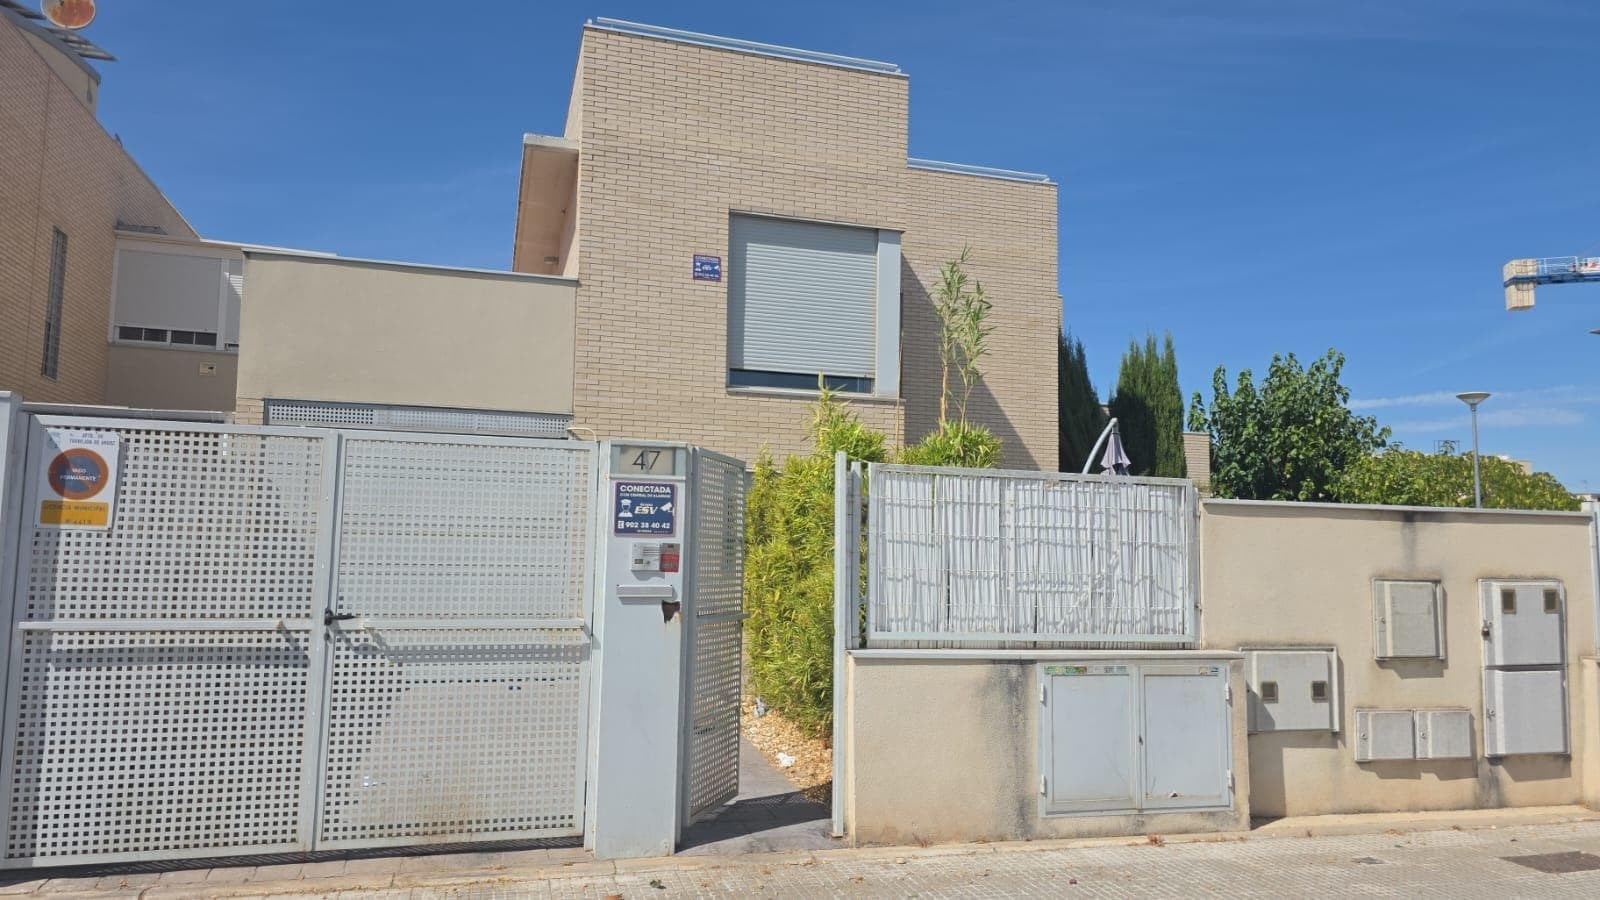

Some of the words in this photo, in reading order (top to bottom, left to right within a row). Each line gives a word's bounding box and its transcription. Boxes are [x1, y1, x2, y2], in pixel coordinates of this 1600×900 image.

[632, 450, 661, 470] 47
[620, 485, 671, 493] CONECTADA
[634, 505, 658, 515] ESV
